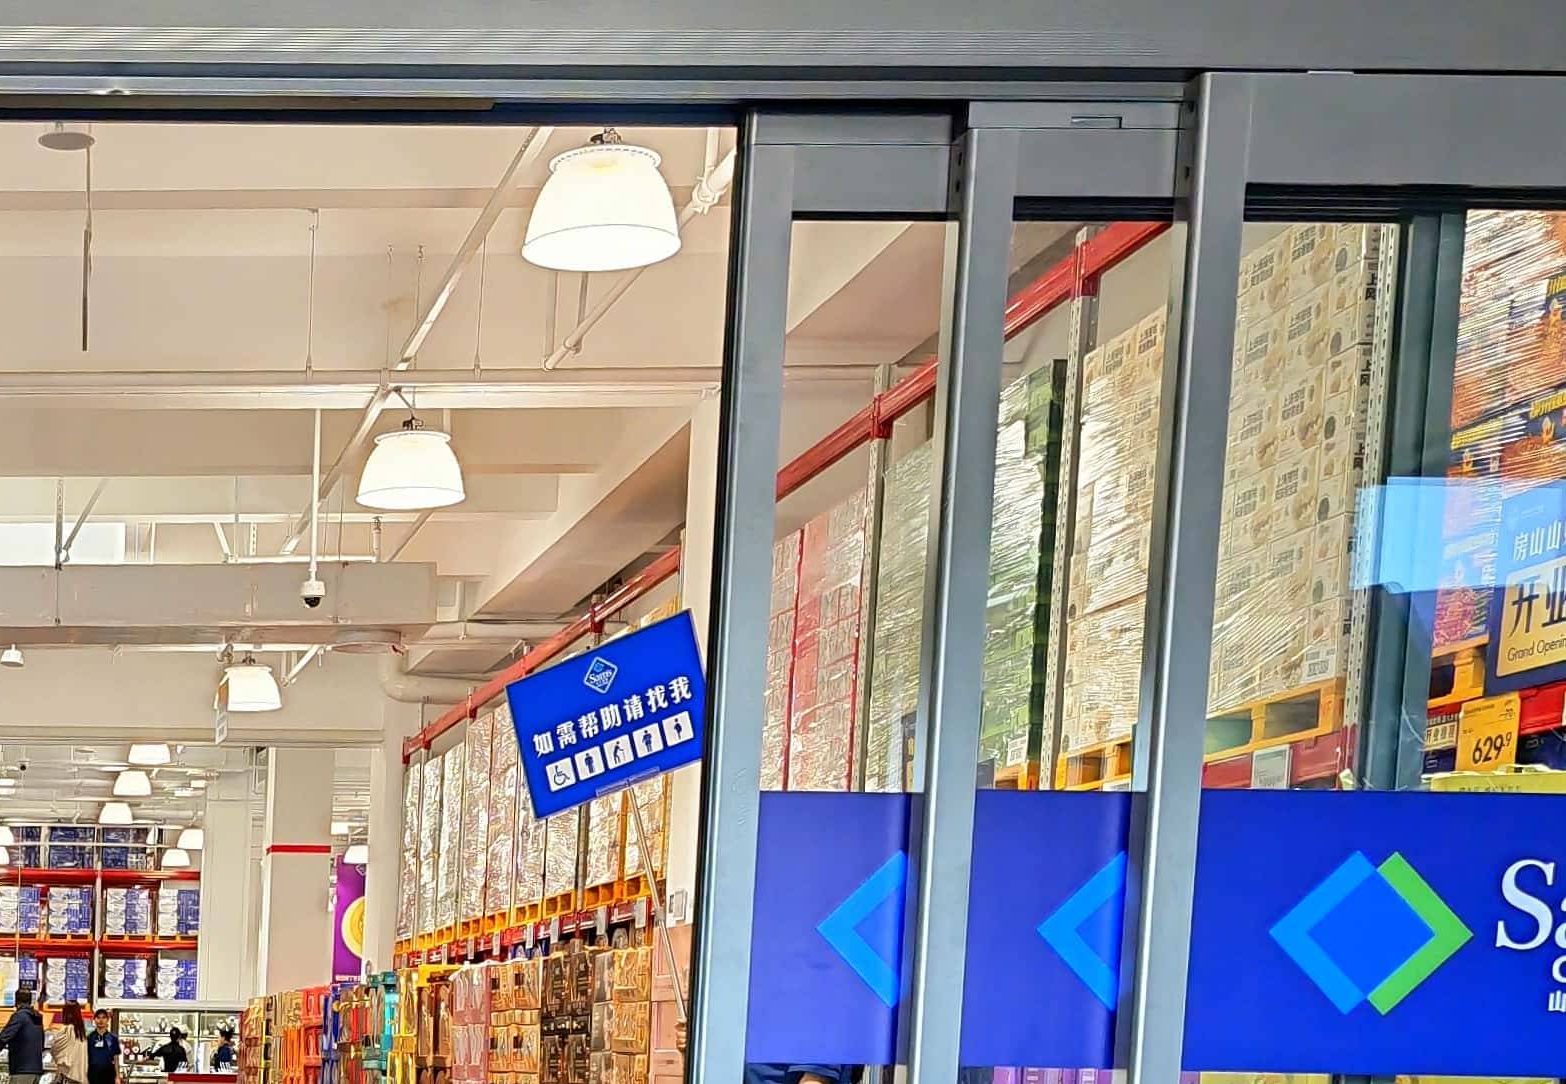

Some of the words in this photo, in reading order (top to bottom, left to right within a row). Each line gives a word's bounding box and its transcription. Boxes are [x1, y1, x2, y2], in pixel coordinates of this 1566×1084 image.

[1513, 519, 1566, 561] 房山山
[1507, 639, 1535, 662] Grand
[532, 675, 693, 758] 如需帮助请找我
